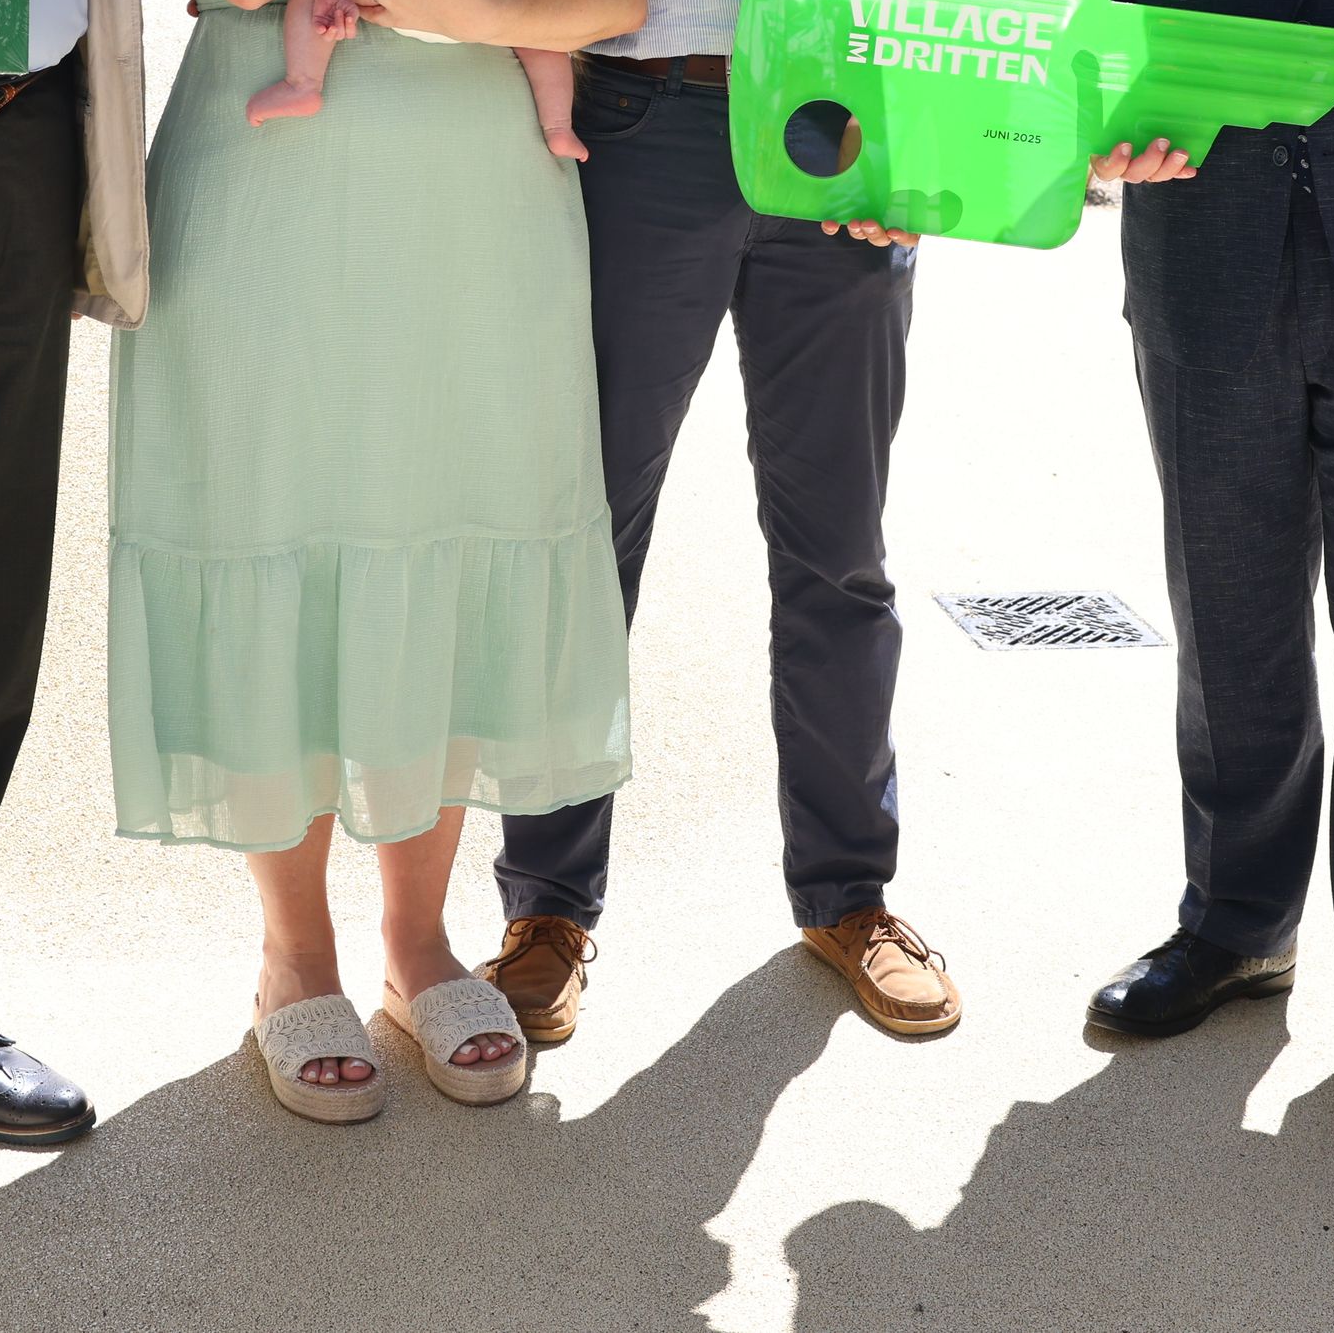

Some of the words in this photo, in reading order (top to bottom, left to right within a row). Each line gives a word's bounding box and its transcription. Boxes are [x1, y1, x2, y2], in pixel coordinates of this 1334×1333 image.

[846, 33, 870, 64] IM
[872, 35, 1050, 87] DRITTEN
[983, 129, 1010, 140] JUNI
[1012, 132, 1042, 144] 2025
